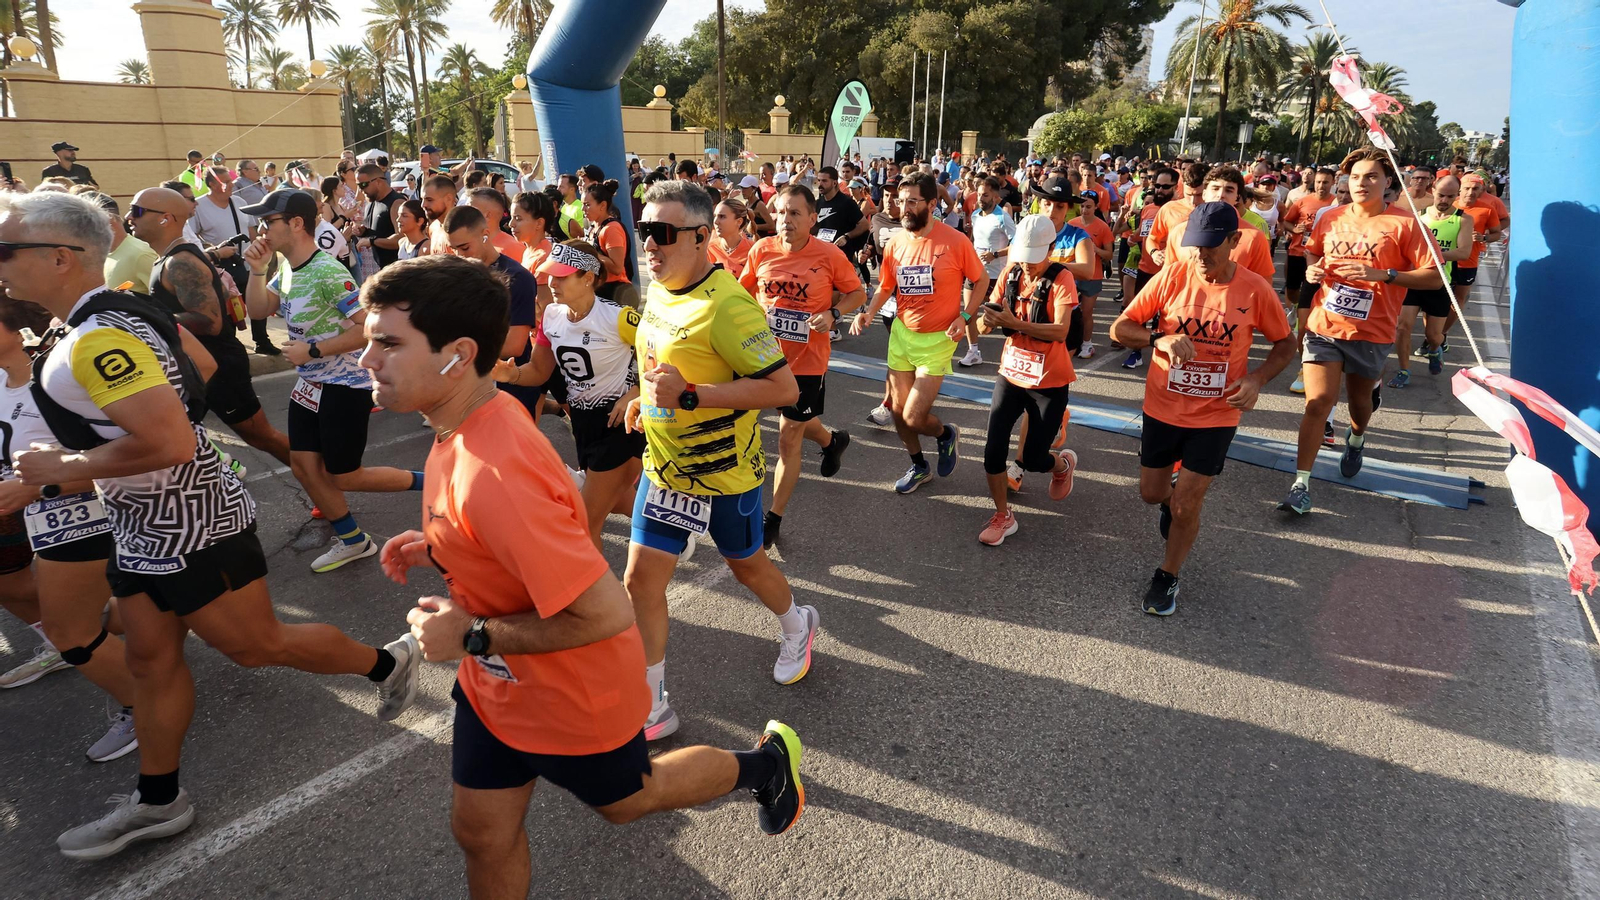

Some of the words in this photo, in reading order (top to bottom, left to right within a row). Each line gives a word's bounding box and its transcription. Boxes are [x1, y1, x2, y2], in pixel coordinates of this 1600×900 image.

[841, 115, 859, 123] SPORT
[819, 207, 833, 216] NIKE
[903, 275, 922, 286] 721
[1335, 295, 1361, 309] 697
[775, 318, 798, 332] 810
[741, 329, 768, 350] JUNTOS
[1012, 358, 1033, 373] 332
[107, 369, 144, 390] asodena
[1181, 371, 1212, 387] 333
[300, 382, 315, 399] 264
[659, 488, 701, 517] 1110
[45, 504, 91, 529] 823
